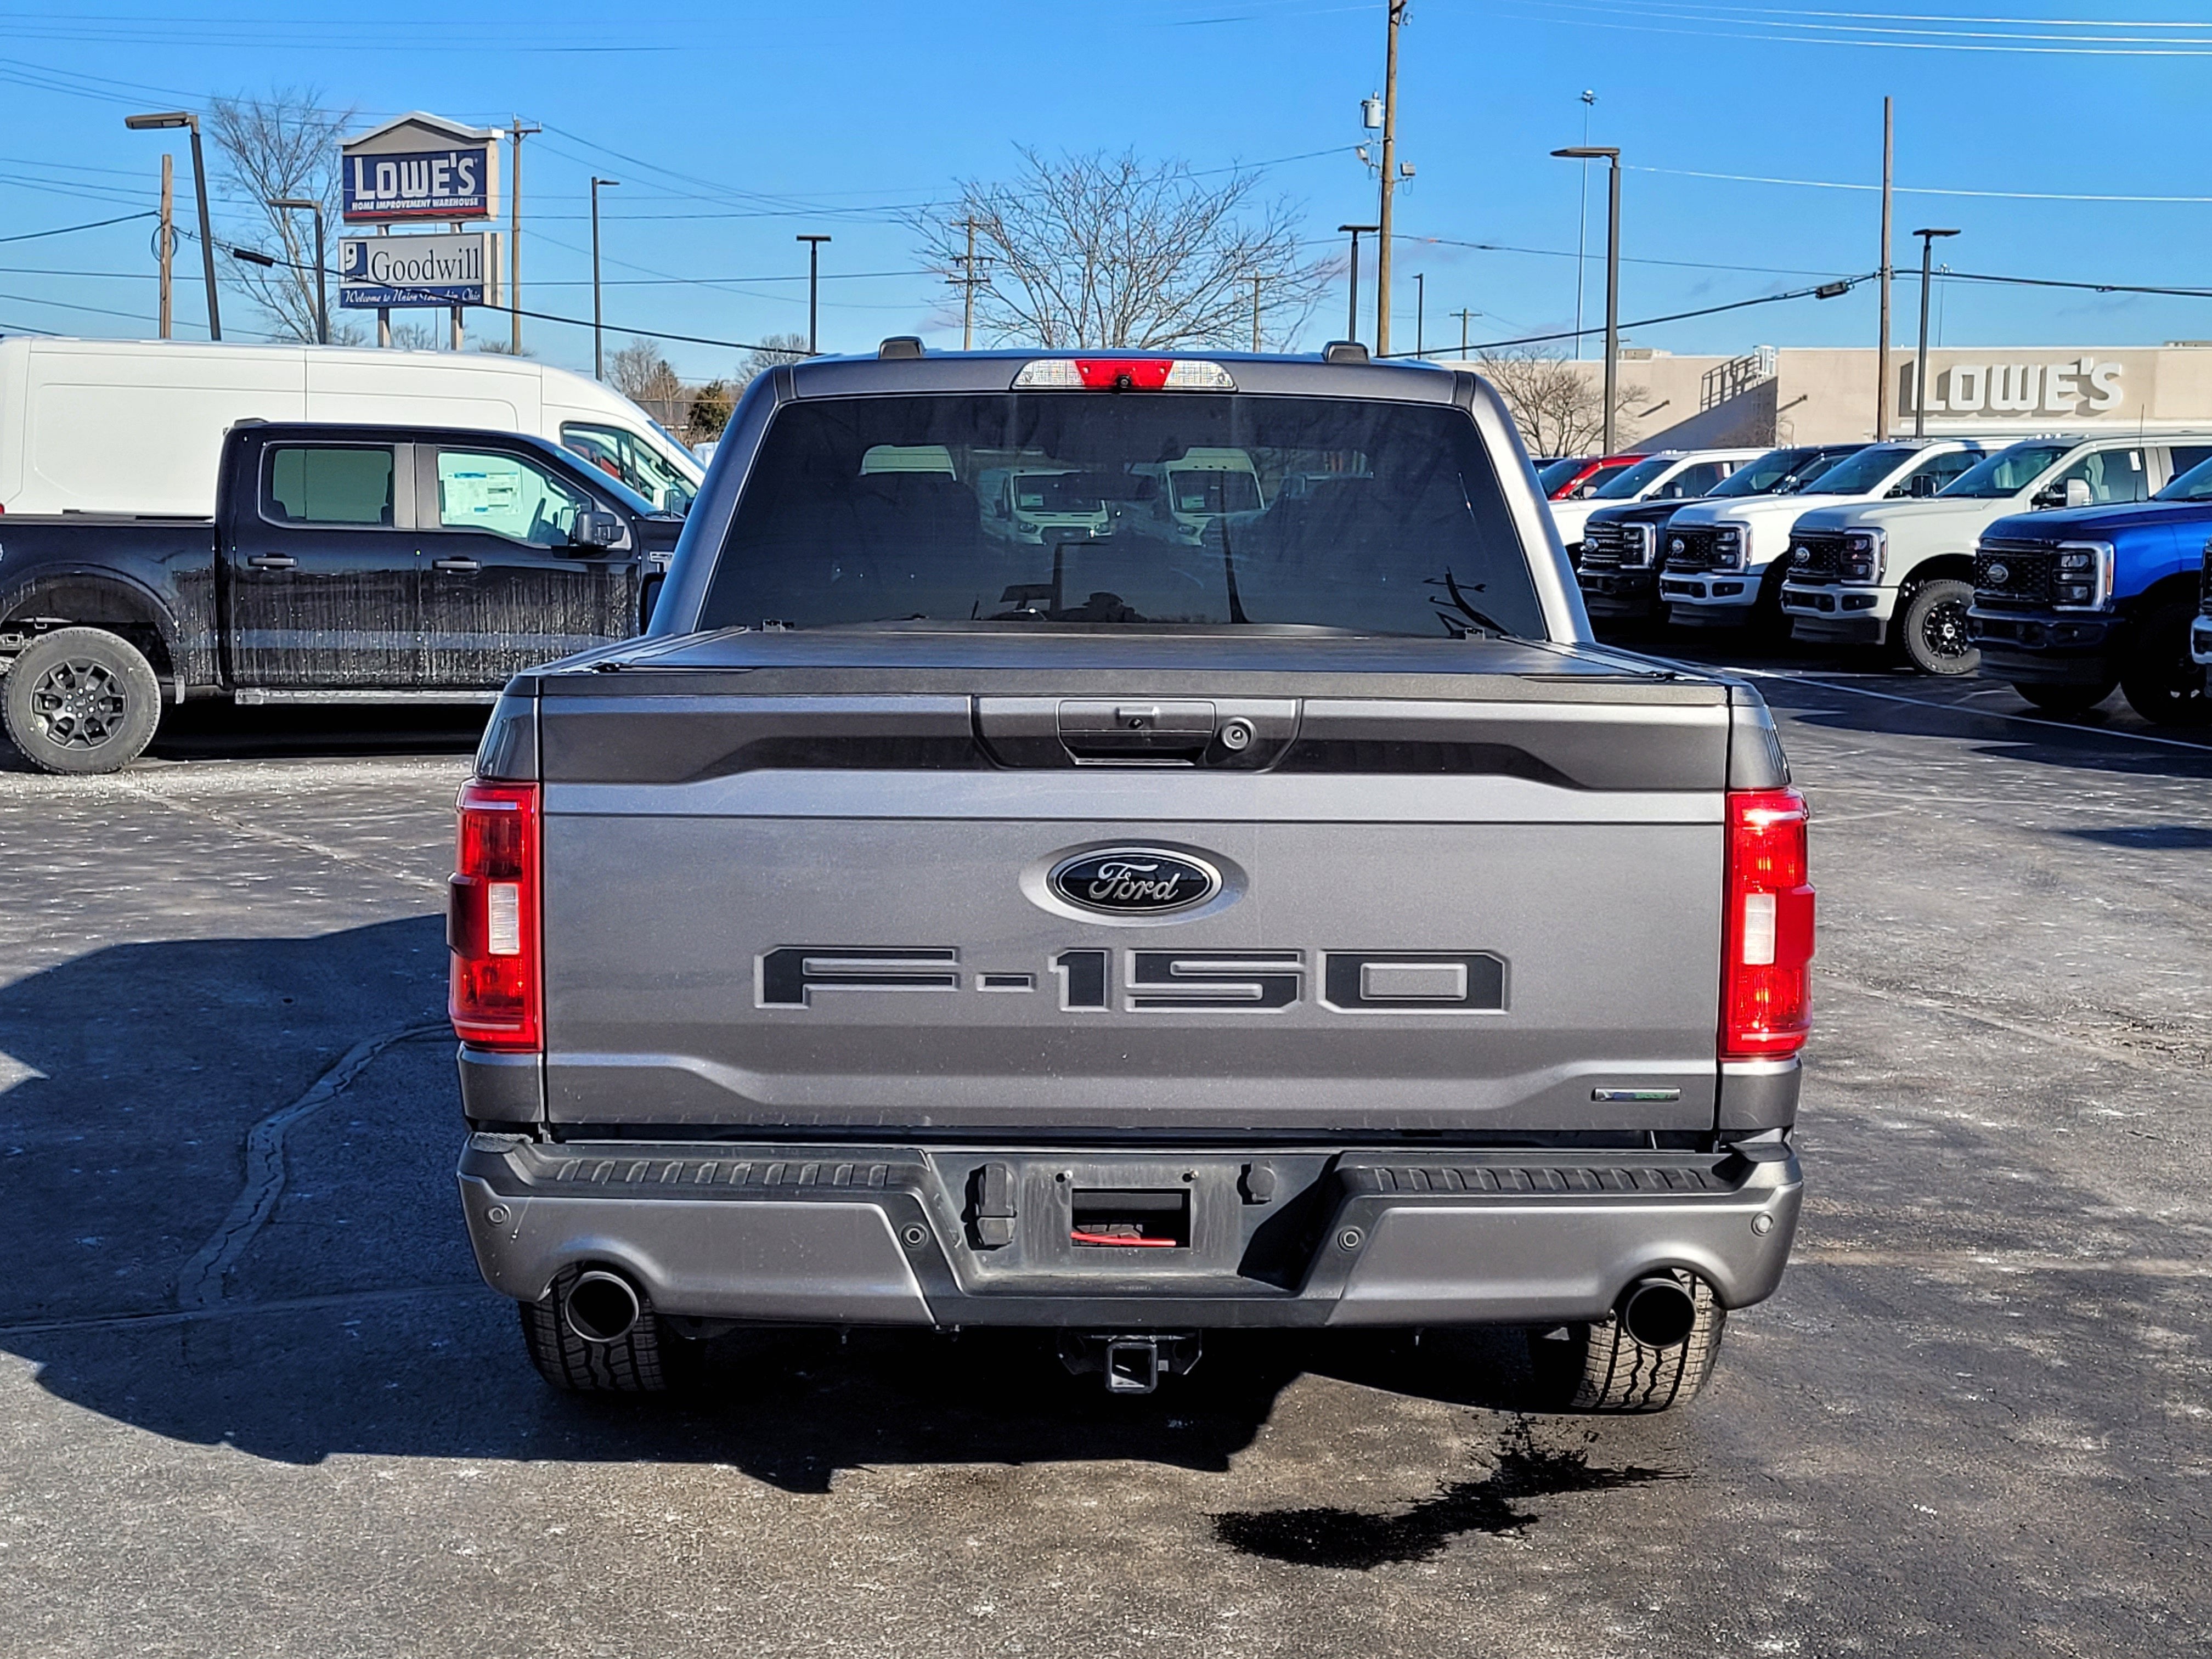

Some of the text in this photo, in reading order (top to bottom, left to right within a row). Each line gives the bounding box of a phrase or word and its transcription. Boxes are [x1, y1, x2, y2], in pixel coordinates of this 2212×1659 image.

[354, 152, 476, 200] LOWE'S
[352, 198, 479, 211] HOME IMPROVEMENT WAREHOUSE
[371, 247, 480, 282] Goodwill
[345, 290, 381, 303] Welcome
[383, 293, 391, 302] to
[462, 287, 481, 301] Ohio
[1911, 357, 2123, 412] LOWE'S
[1088, 862, 1181, 901] Ford
[754, 944, 1510, 1015] F-150
